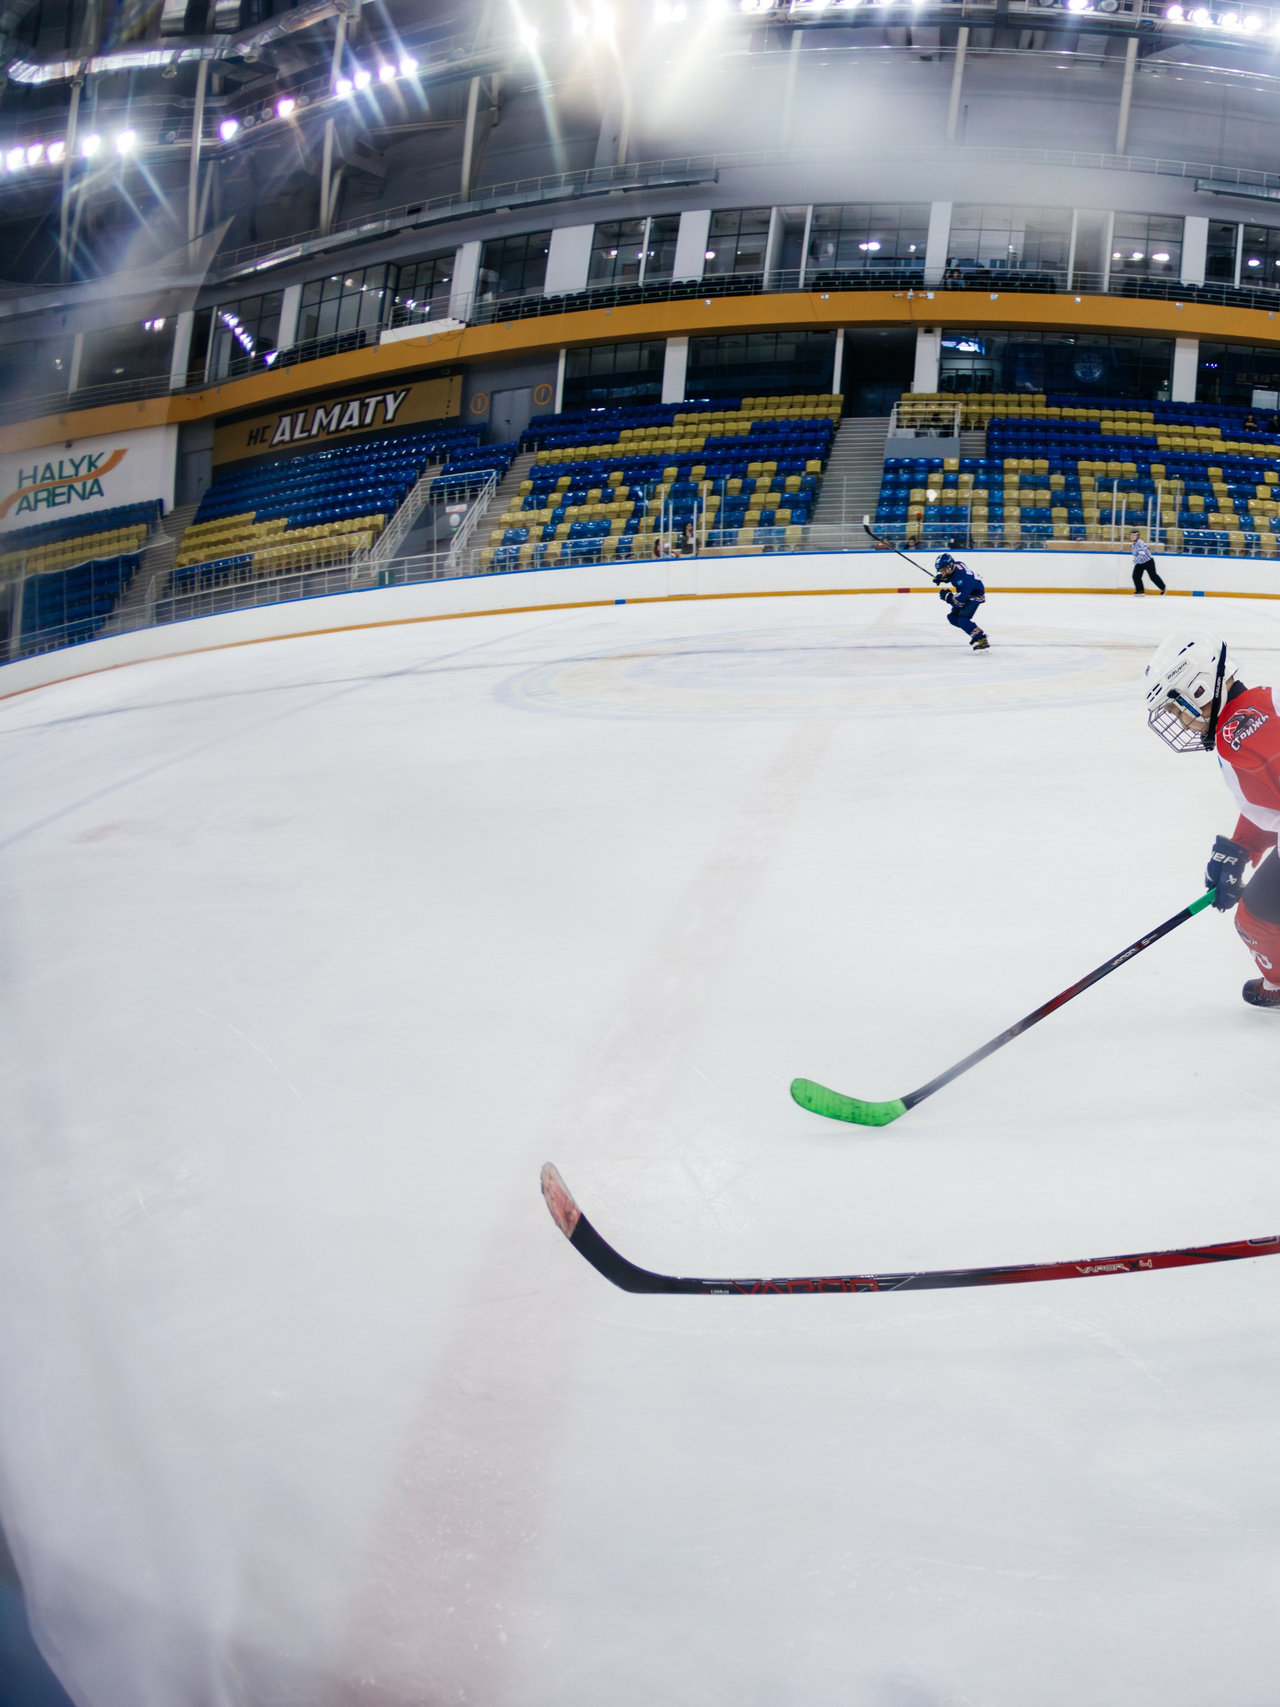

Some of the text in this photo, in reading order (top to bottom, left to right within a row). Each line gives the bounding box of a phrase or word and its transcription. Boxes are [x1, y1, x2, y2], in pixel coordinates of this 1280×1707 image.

[246, 386, 413, 448] HC ALMATY
[17, 451, 105, 490] HALYK
[15, 477, 105, 516] ARENA
[1075, 1261, 1130, 1275] VAPOR
